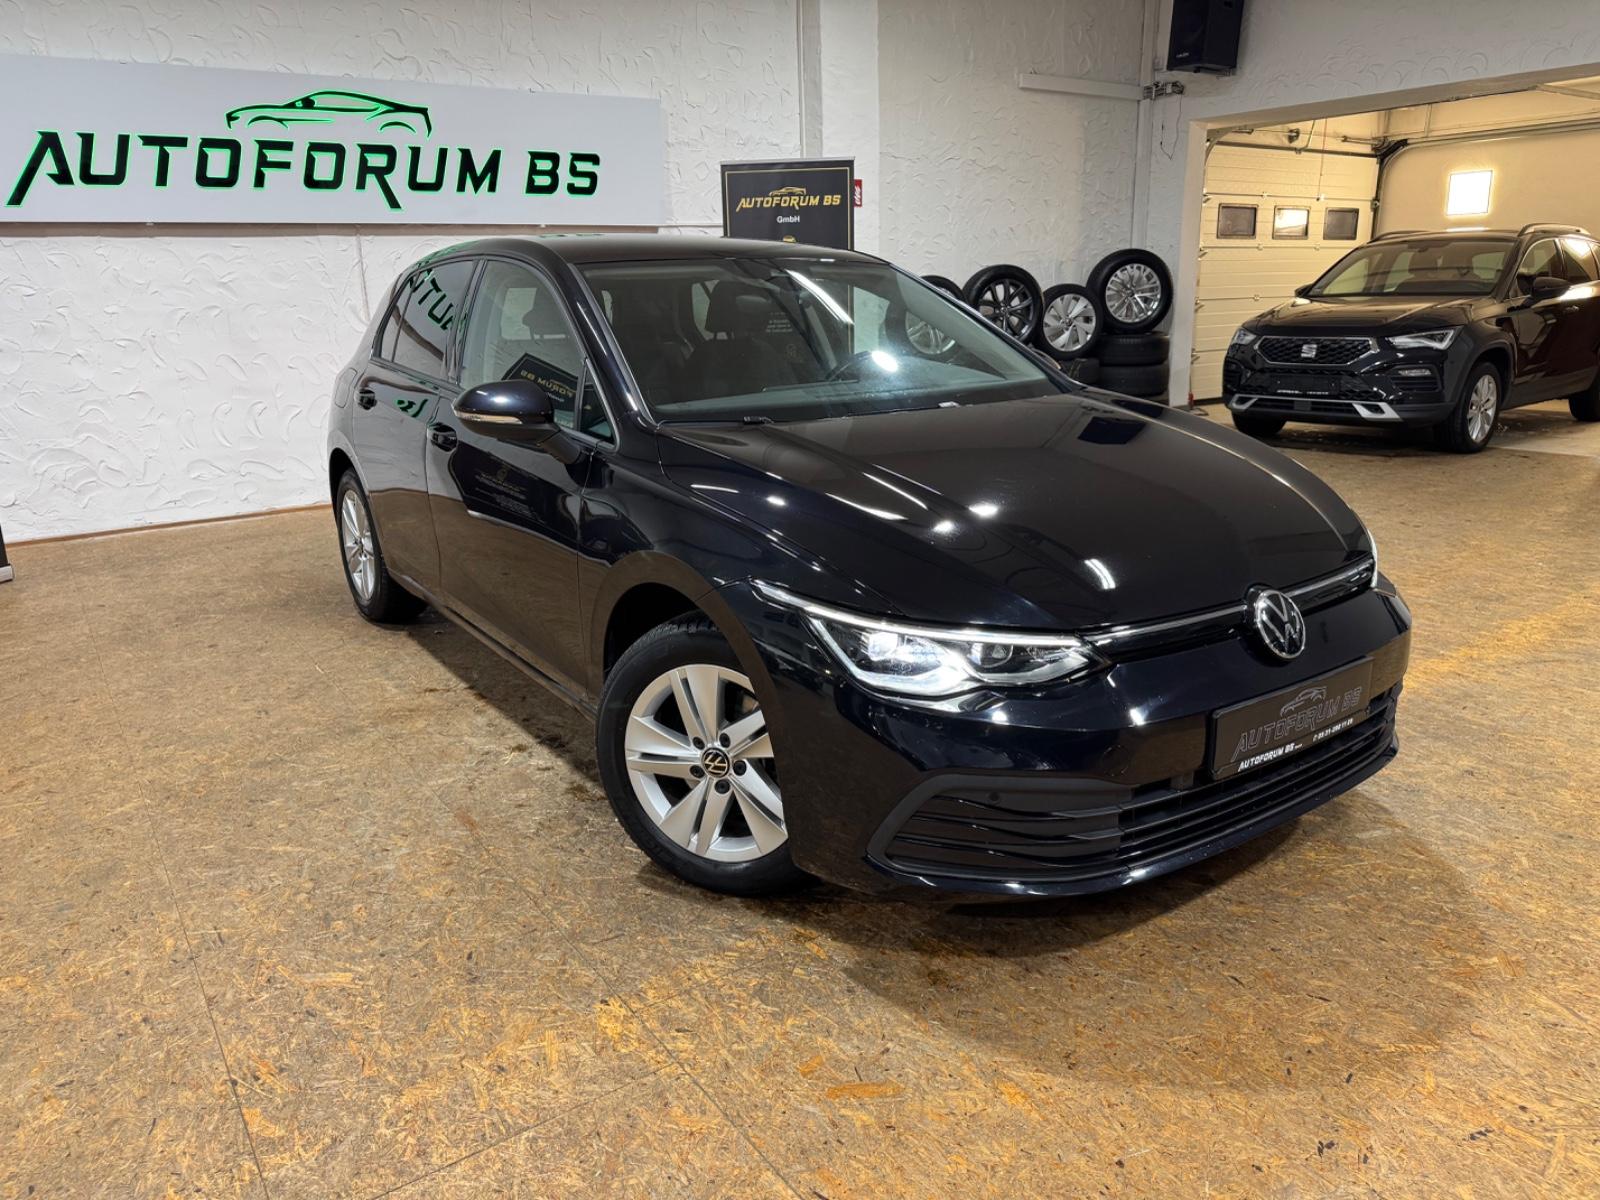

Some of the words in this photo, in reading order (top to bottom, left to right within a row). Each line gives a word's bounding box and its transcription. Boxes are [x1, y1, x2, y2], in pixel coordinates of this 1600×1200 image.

[6, 129, 502, 212] AUTOFORUM
[524, 150, 601, 196] BS
[736, 195, 820, 212] AUTOFORUM
[822, 195, 841, 206] BS
[776, 215, 800, 223] GmbH
[1231, 695, 1341, 763] AUTOFORUM
[1237, 746, 1284, 772] AUTOFORUM
